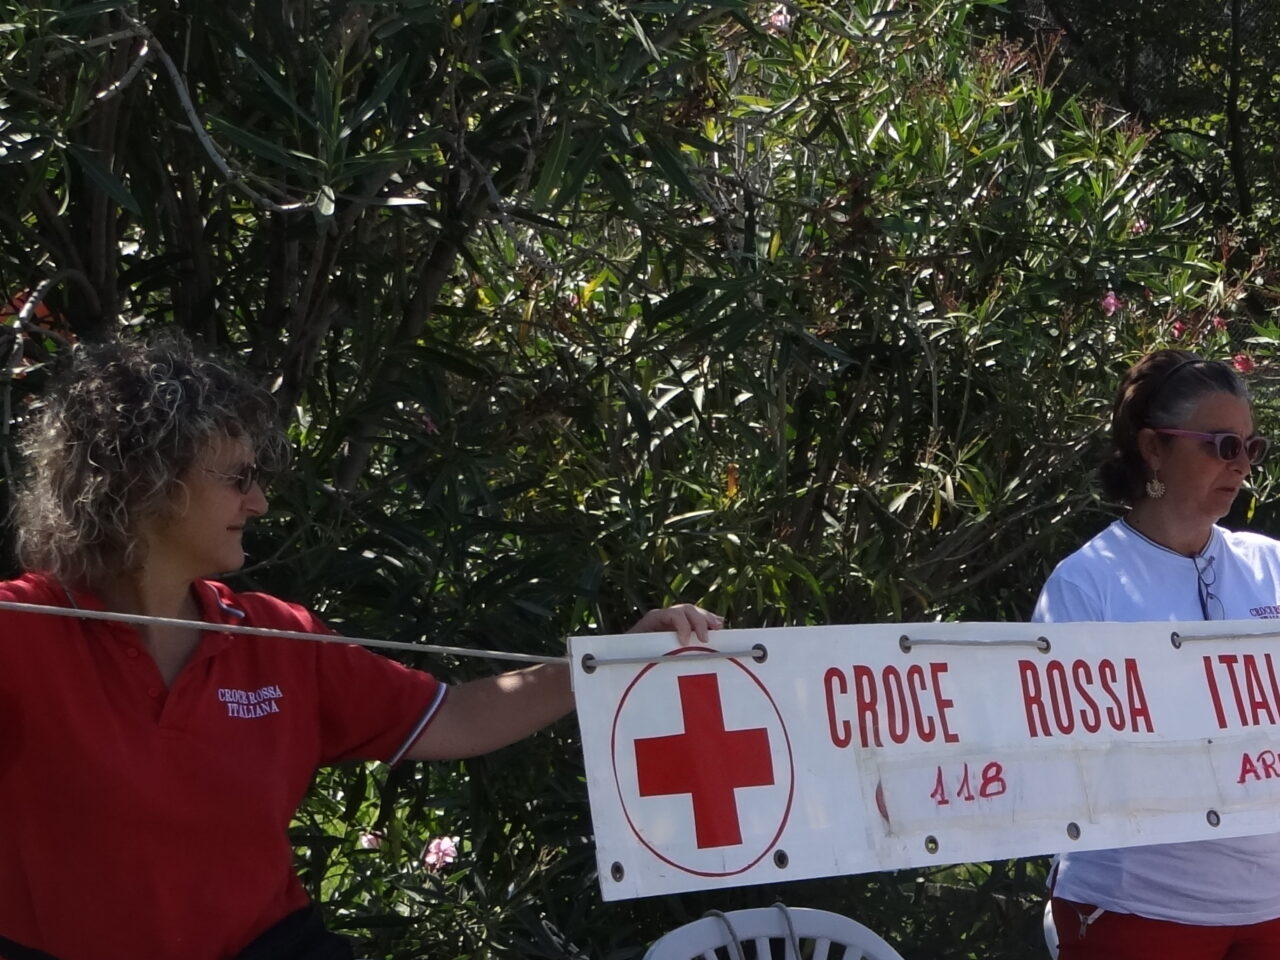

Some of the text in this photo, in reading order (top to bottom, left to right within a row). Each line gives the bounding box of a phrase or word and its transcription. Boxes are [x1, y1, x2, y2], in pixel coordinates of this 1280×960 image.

[218, 684, 284, 704] CROCE ROSSA
[227, 700, 280, 719] ITALIANA
[823, 662, 960, 749] CROCE
[1018, 657, 1155, 738] ROSSA
[929, 761, 1008, 806] 118
